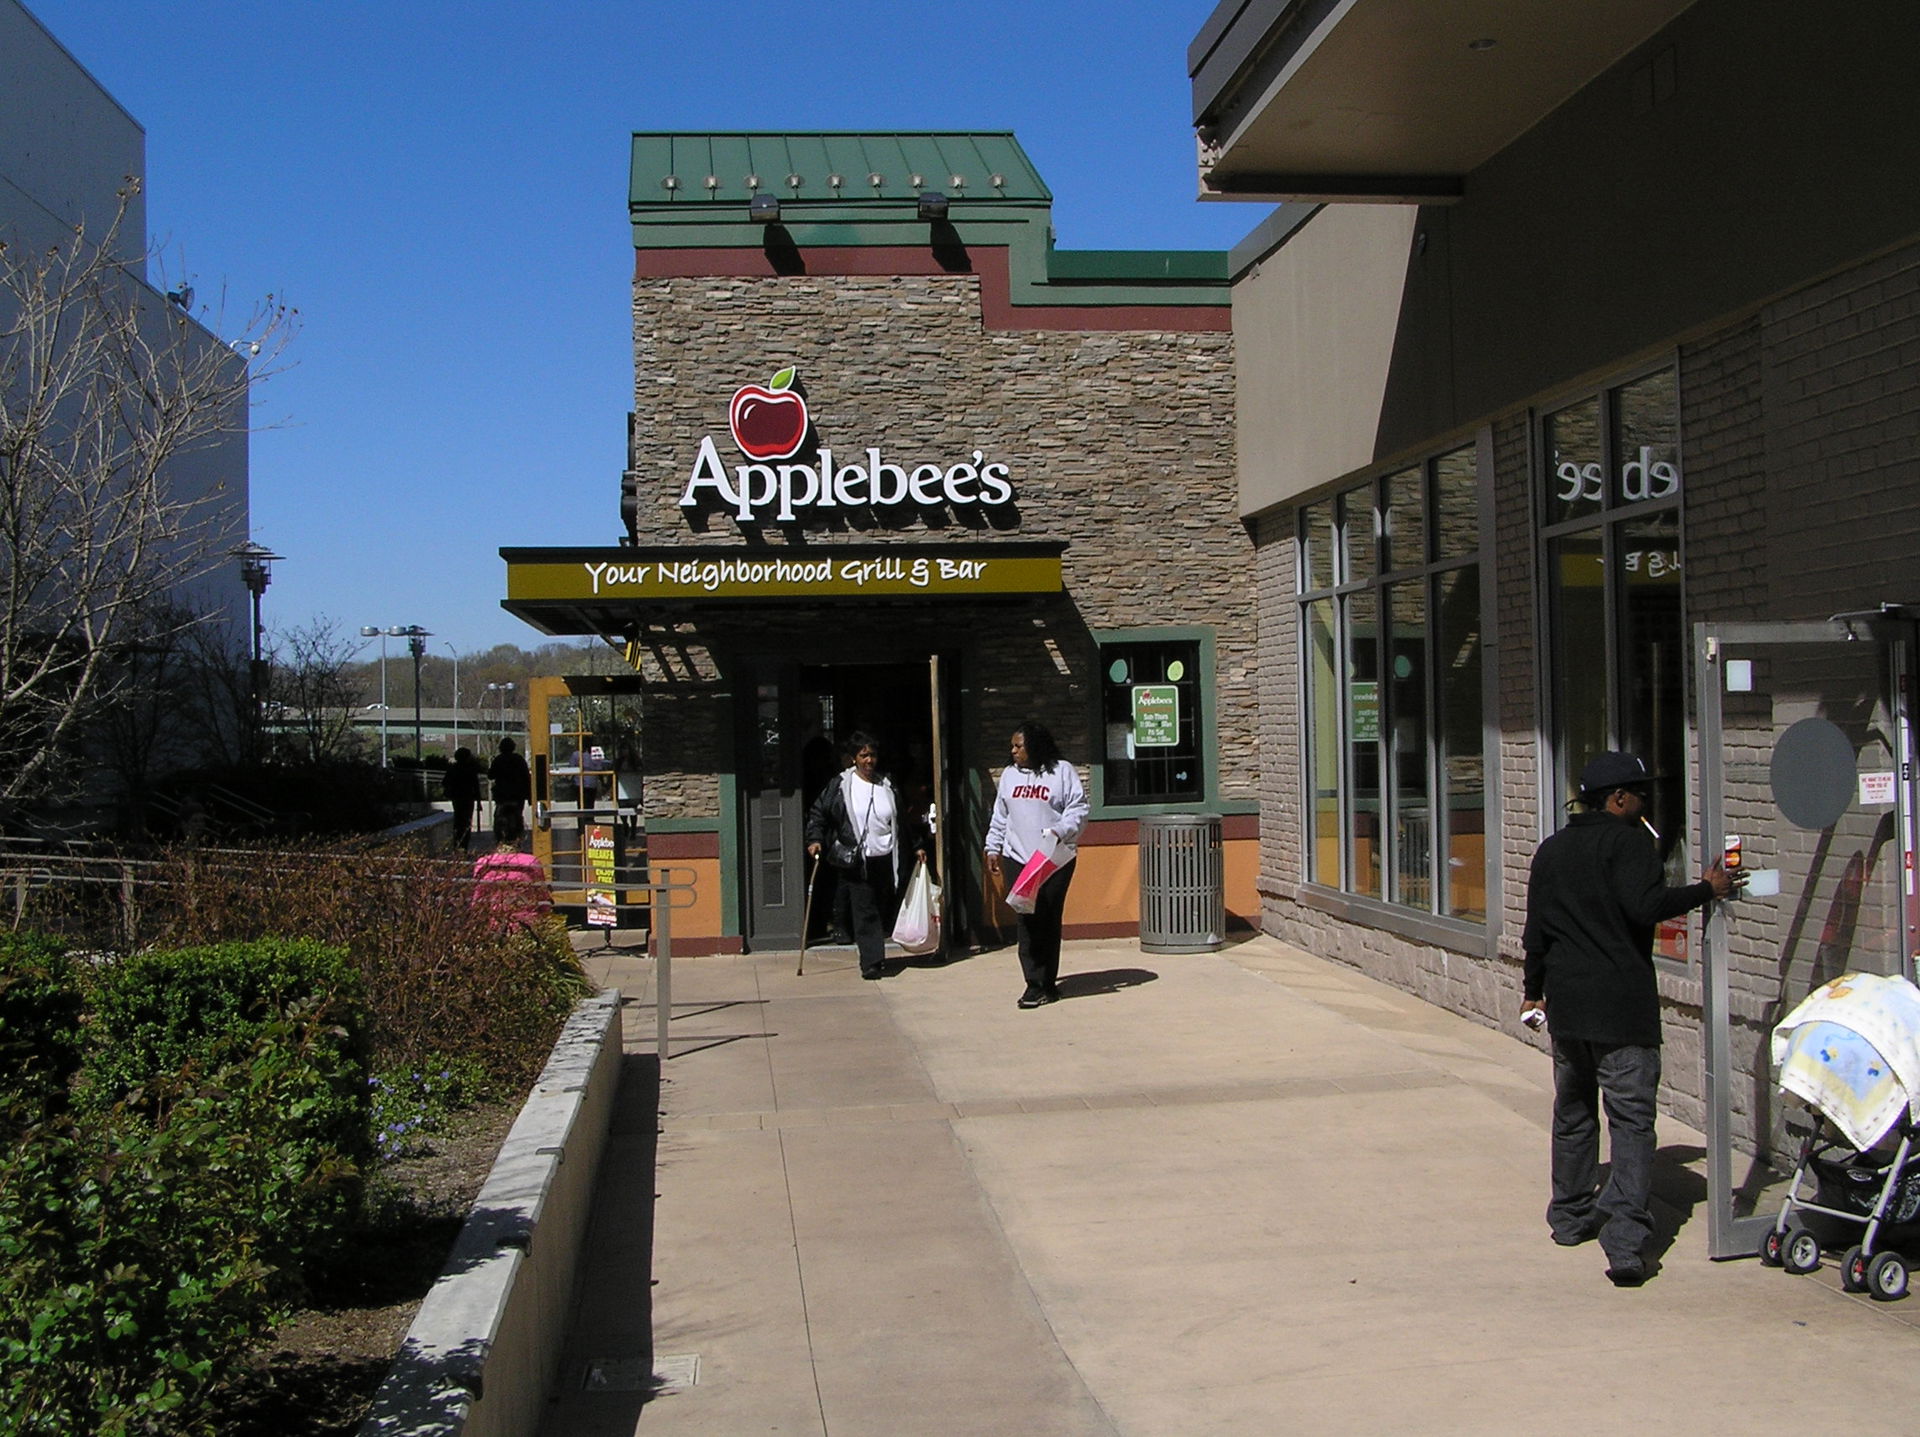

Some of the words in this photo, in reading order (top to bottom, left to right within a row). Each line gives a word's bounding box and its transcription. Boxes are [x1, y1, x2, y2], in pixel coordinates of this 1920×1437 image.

[679, 435, 1012, 521] Applebee's
[584, 561, 651, 594] Your
[658, 557, 832, 591] Neighborhood
[840, 556, 905, 586] Grill
[909, 558, 929, 587] &
[936, 558, 987, 580] Bar
[1012, 784, 1050, 801] USMC
